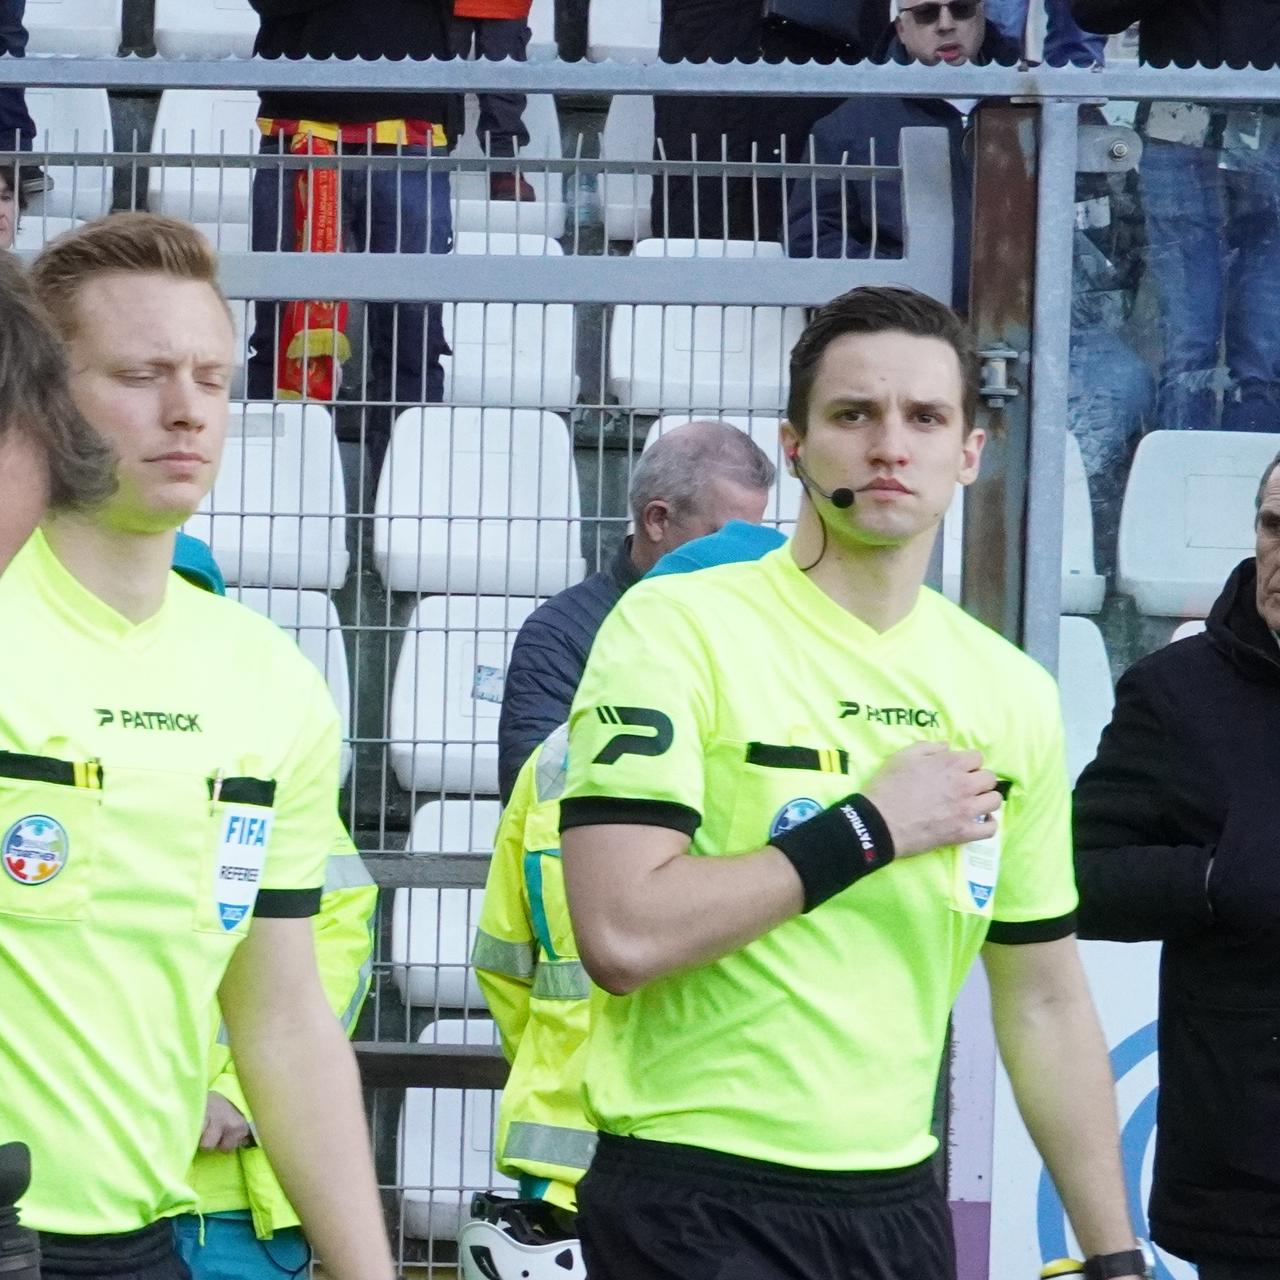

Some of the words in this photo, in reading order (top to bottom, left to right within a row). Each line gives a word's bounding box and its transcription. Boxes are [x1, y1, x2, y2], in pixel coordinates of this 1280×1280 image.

[120, 709, 203, 732] PATRICK
[866, 704, 940, 728] PATRICK
[226, 816, 266, 846] FIFA
[840, 803, 874, 851] PATRICK
